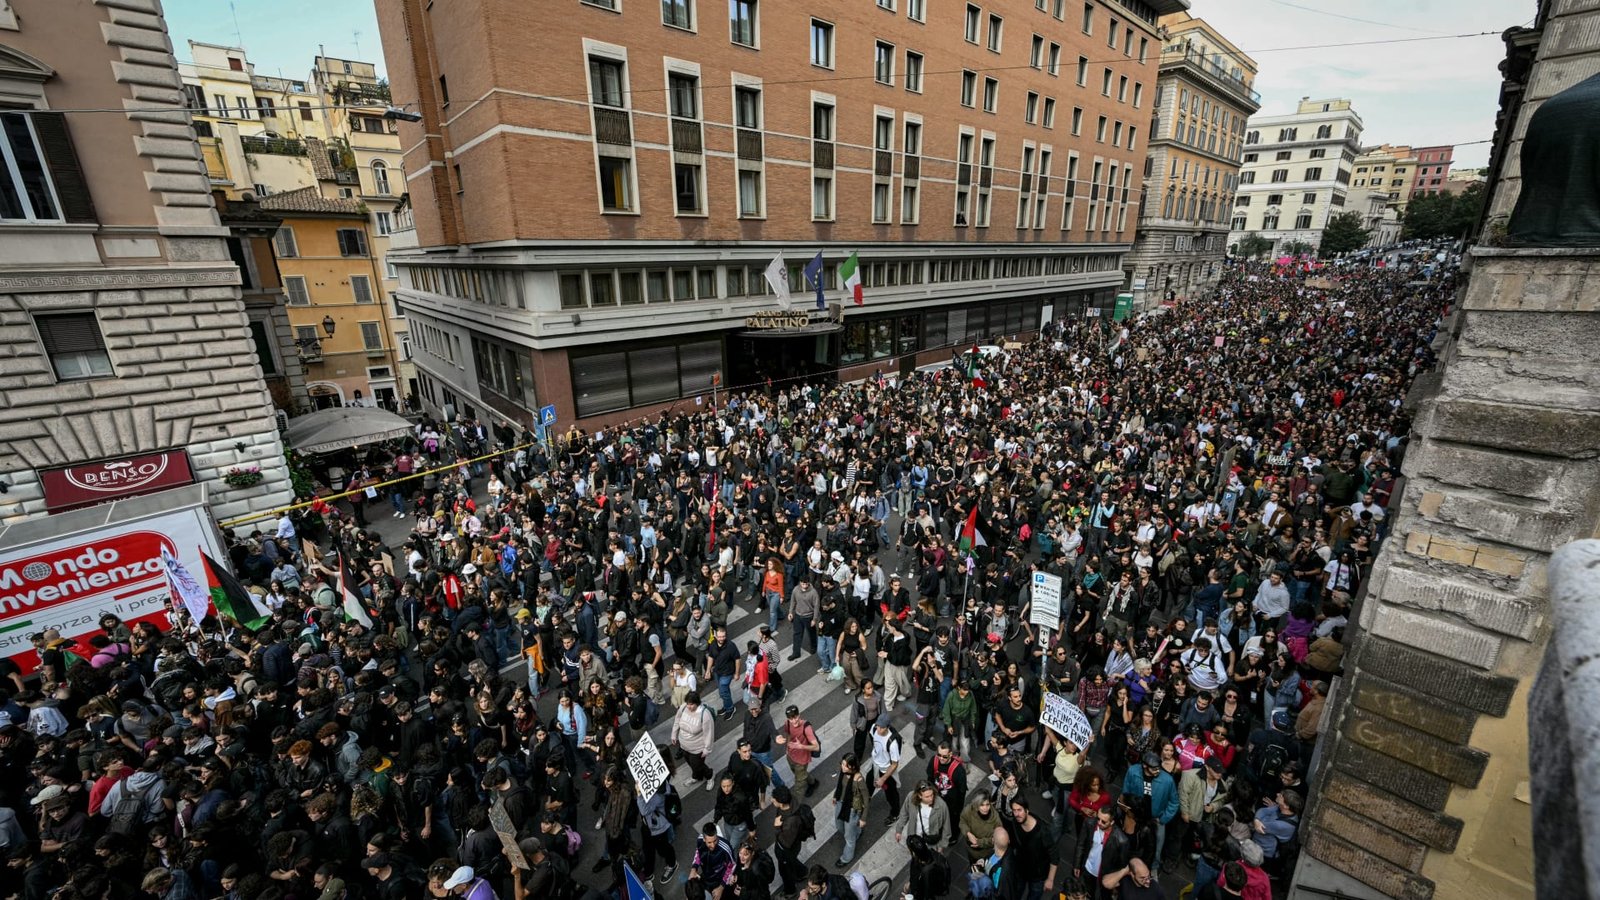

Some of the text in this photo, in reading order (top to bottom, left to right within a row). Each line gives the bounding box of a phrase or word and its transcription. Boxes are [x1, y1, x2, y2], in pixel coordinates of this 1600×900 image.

[746, 316, 809, 328] PALATINO
[84, 463, 158, 483] BENSO
[115, 604, 124, 614] il
[1042, 712, 1069, 734] CERTO
[1045, 703, 1057, 717] MA
[1056, 710, 1073, 727] FINO
[1080, 725, 1091, 737] UN
[634, 744, 660, 790] LO POSSO
[653, 759, 667, 775] ME
